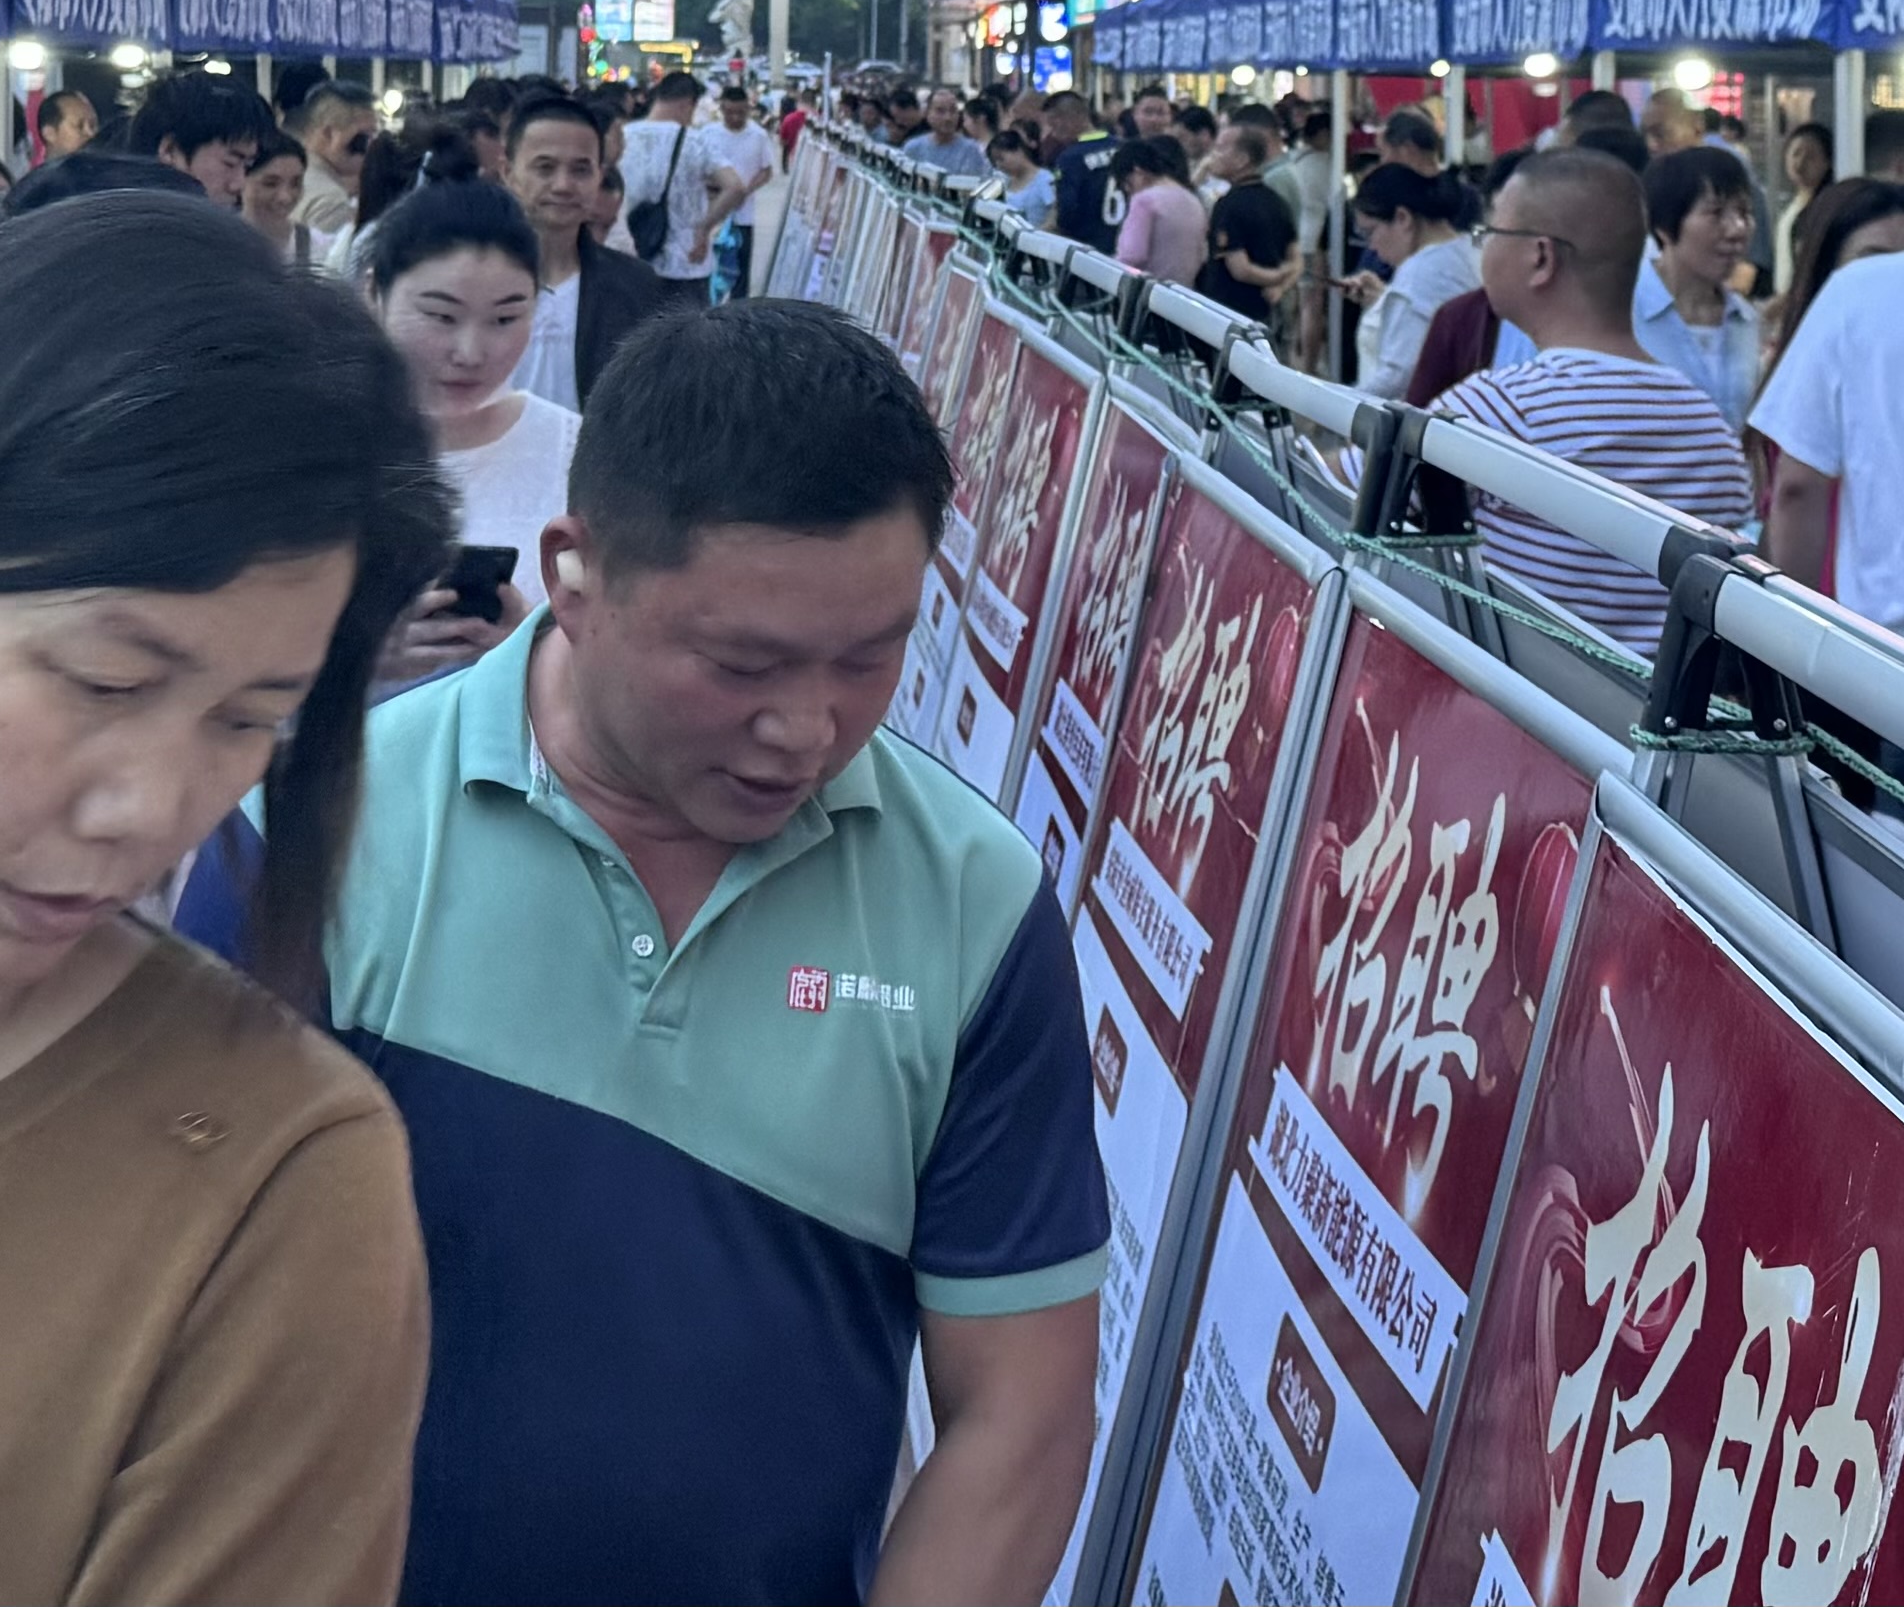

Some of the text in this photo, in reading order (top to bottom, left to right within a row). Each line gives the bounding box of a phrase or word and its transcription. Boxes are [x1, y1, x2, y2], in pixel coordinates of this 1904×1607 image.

[1130, 562, 1263, 902] 招聘
[1308, 731, 1507, 1226] 招聘
[1544, 1060, 1882, 1607] 招聘
